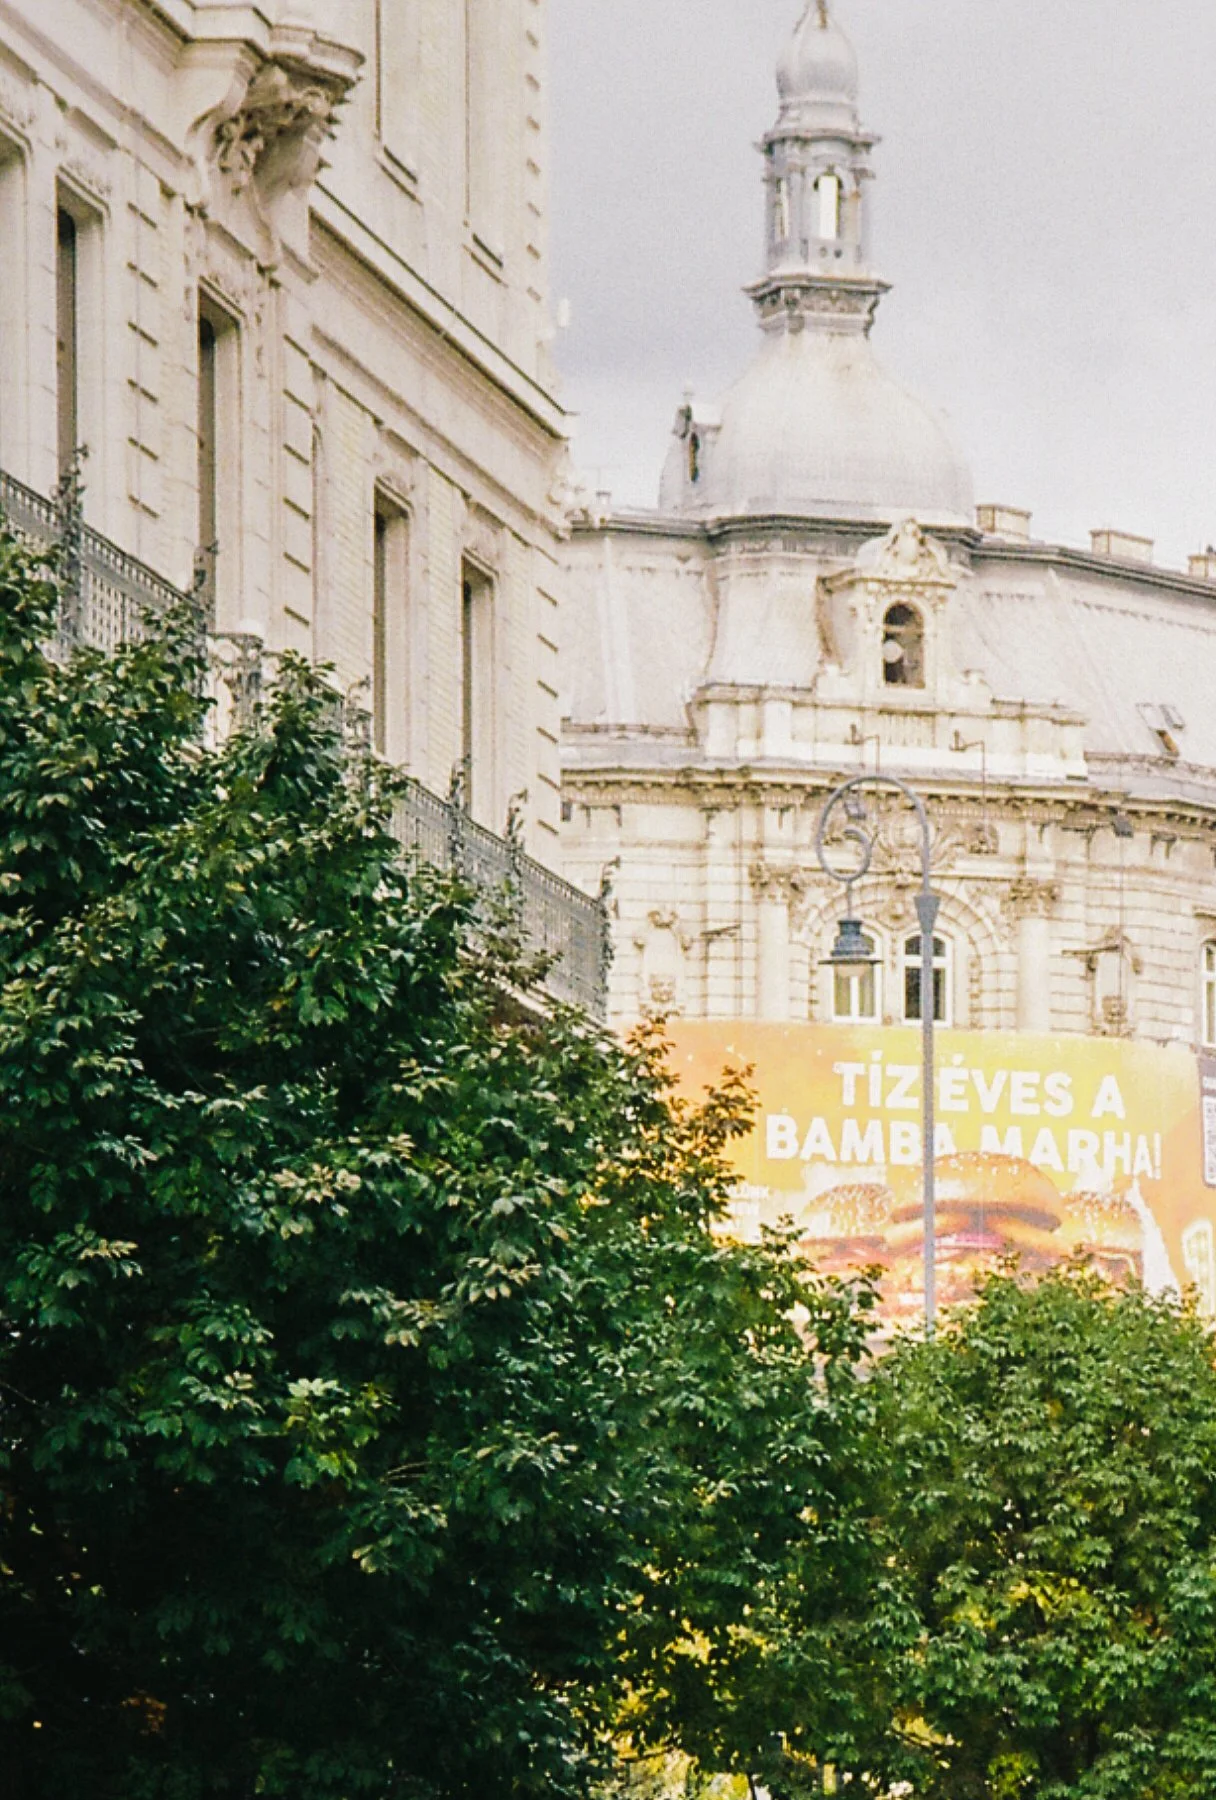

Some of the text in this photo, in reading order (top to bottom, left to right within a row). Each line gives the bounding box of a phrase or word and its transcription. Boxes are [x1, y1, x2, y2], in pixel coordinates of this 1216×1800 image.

[833, 1051, 1126, 1119] TÍZ ÉVES A
